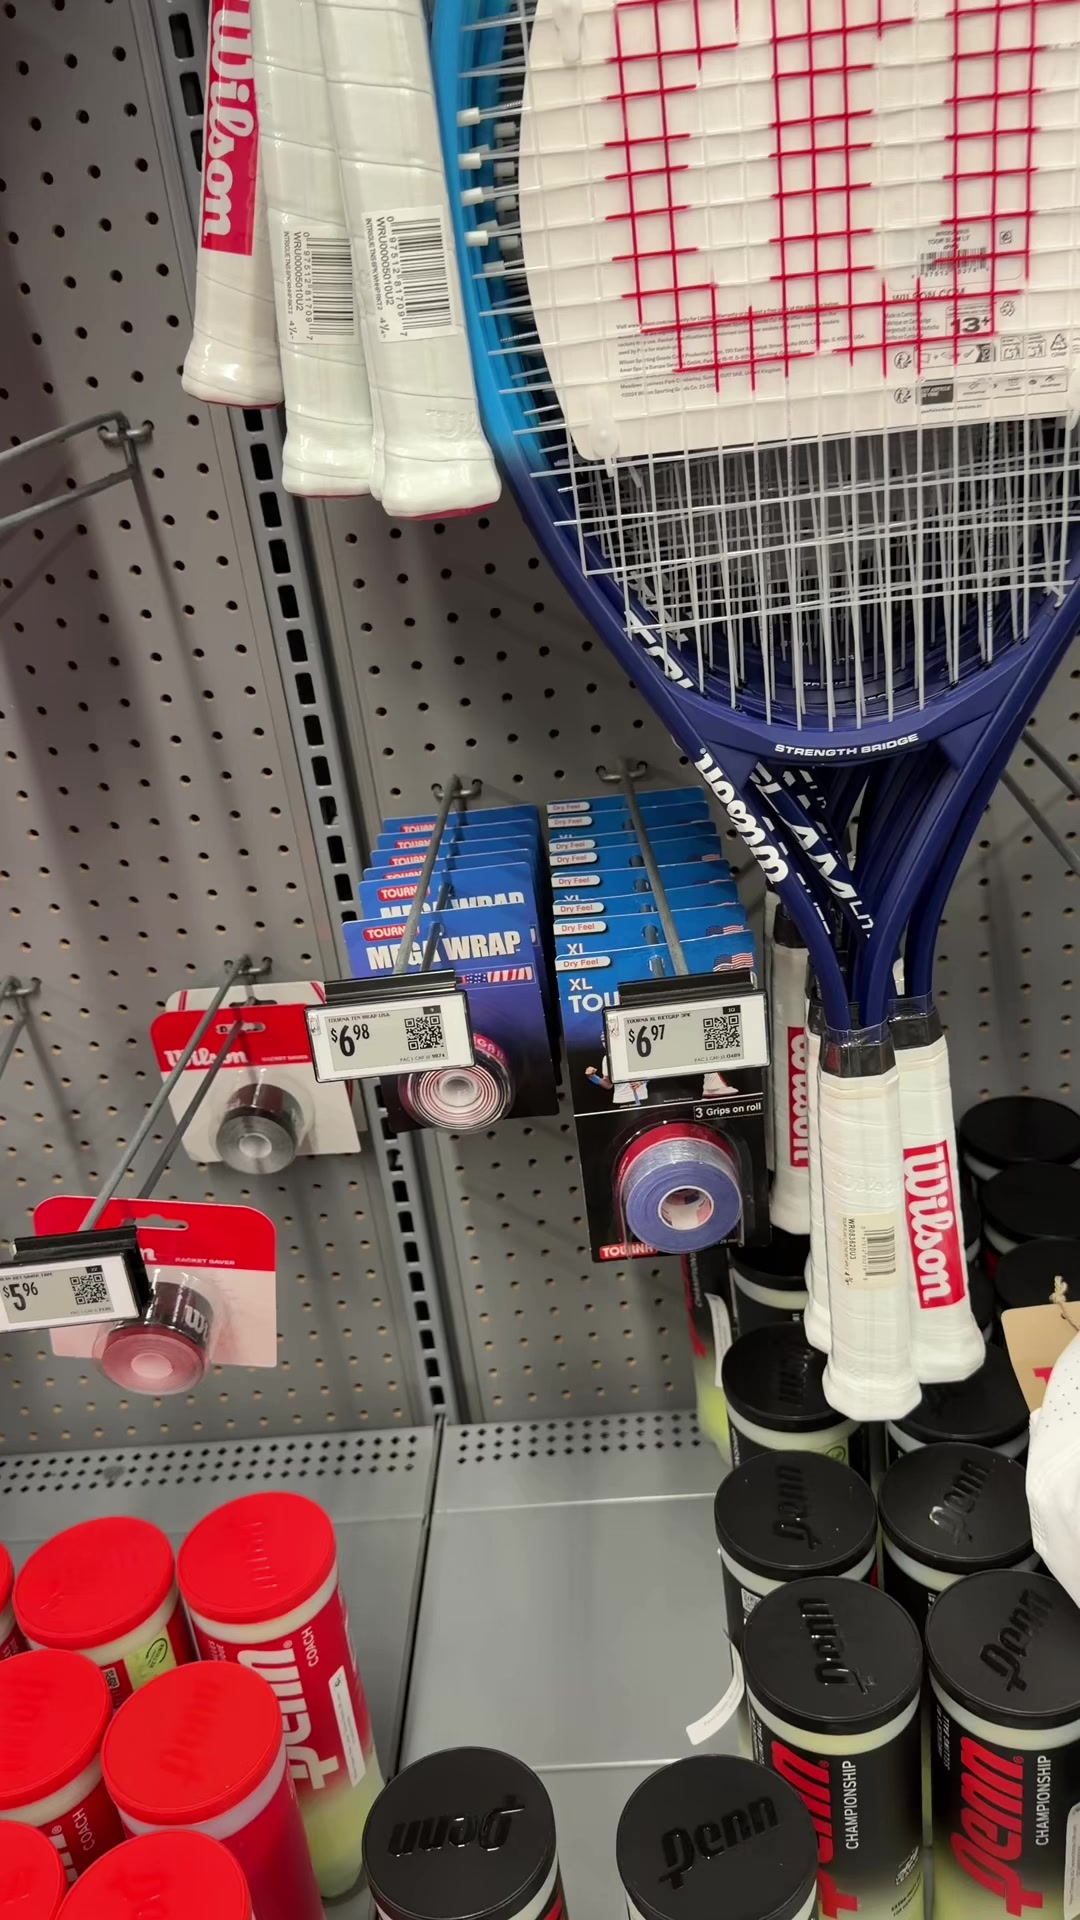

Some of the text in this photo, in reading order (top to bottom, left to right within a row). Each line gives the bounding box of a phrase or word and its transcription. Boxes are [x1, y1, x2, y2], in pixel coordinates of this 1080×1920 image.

[202, 0, 254, 237] Wilson
[774, 732, 920, 757] STRENGTH BRIDGE
[403, 824, 436, 833] TOURN
[397, 839, 431, 850] TOURN
[555, 841, 570, 850] Dry
[391, 855, 427, 865] TOURN
[557, 854, 587, 864] Dry Feel
[558, 876, 590, 886] Dry Feel
[380, 885, 430, 900] TOURN
[560, 904, 593, 914] Dry Feel
[366, 924, 419, 939] TOURN
[561, 922, 595, 933] Dry Feel
[442, 930, 521, 961] WRAP
[563, 958, 599, 969] Dry Feel
[568, 978, 593, 991] XL
[567, 991, 620, 1014] TOU
[695, 1102, 762, 1118] 3 Grips on roll
[903, 1144, 955, 1301] Wilson
[301, 1626, 320, 1668] COACH
[842, 1760, 860, 1850] CHAMPIONSHIP
[1035, 1755, 1052, 1847] CHAMPIONSHIP
[71, 1807, 96, 1852] COACH
